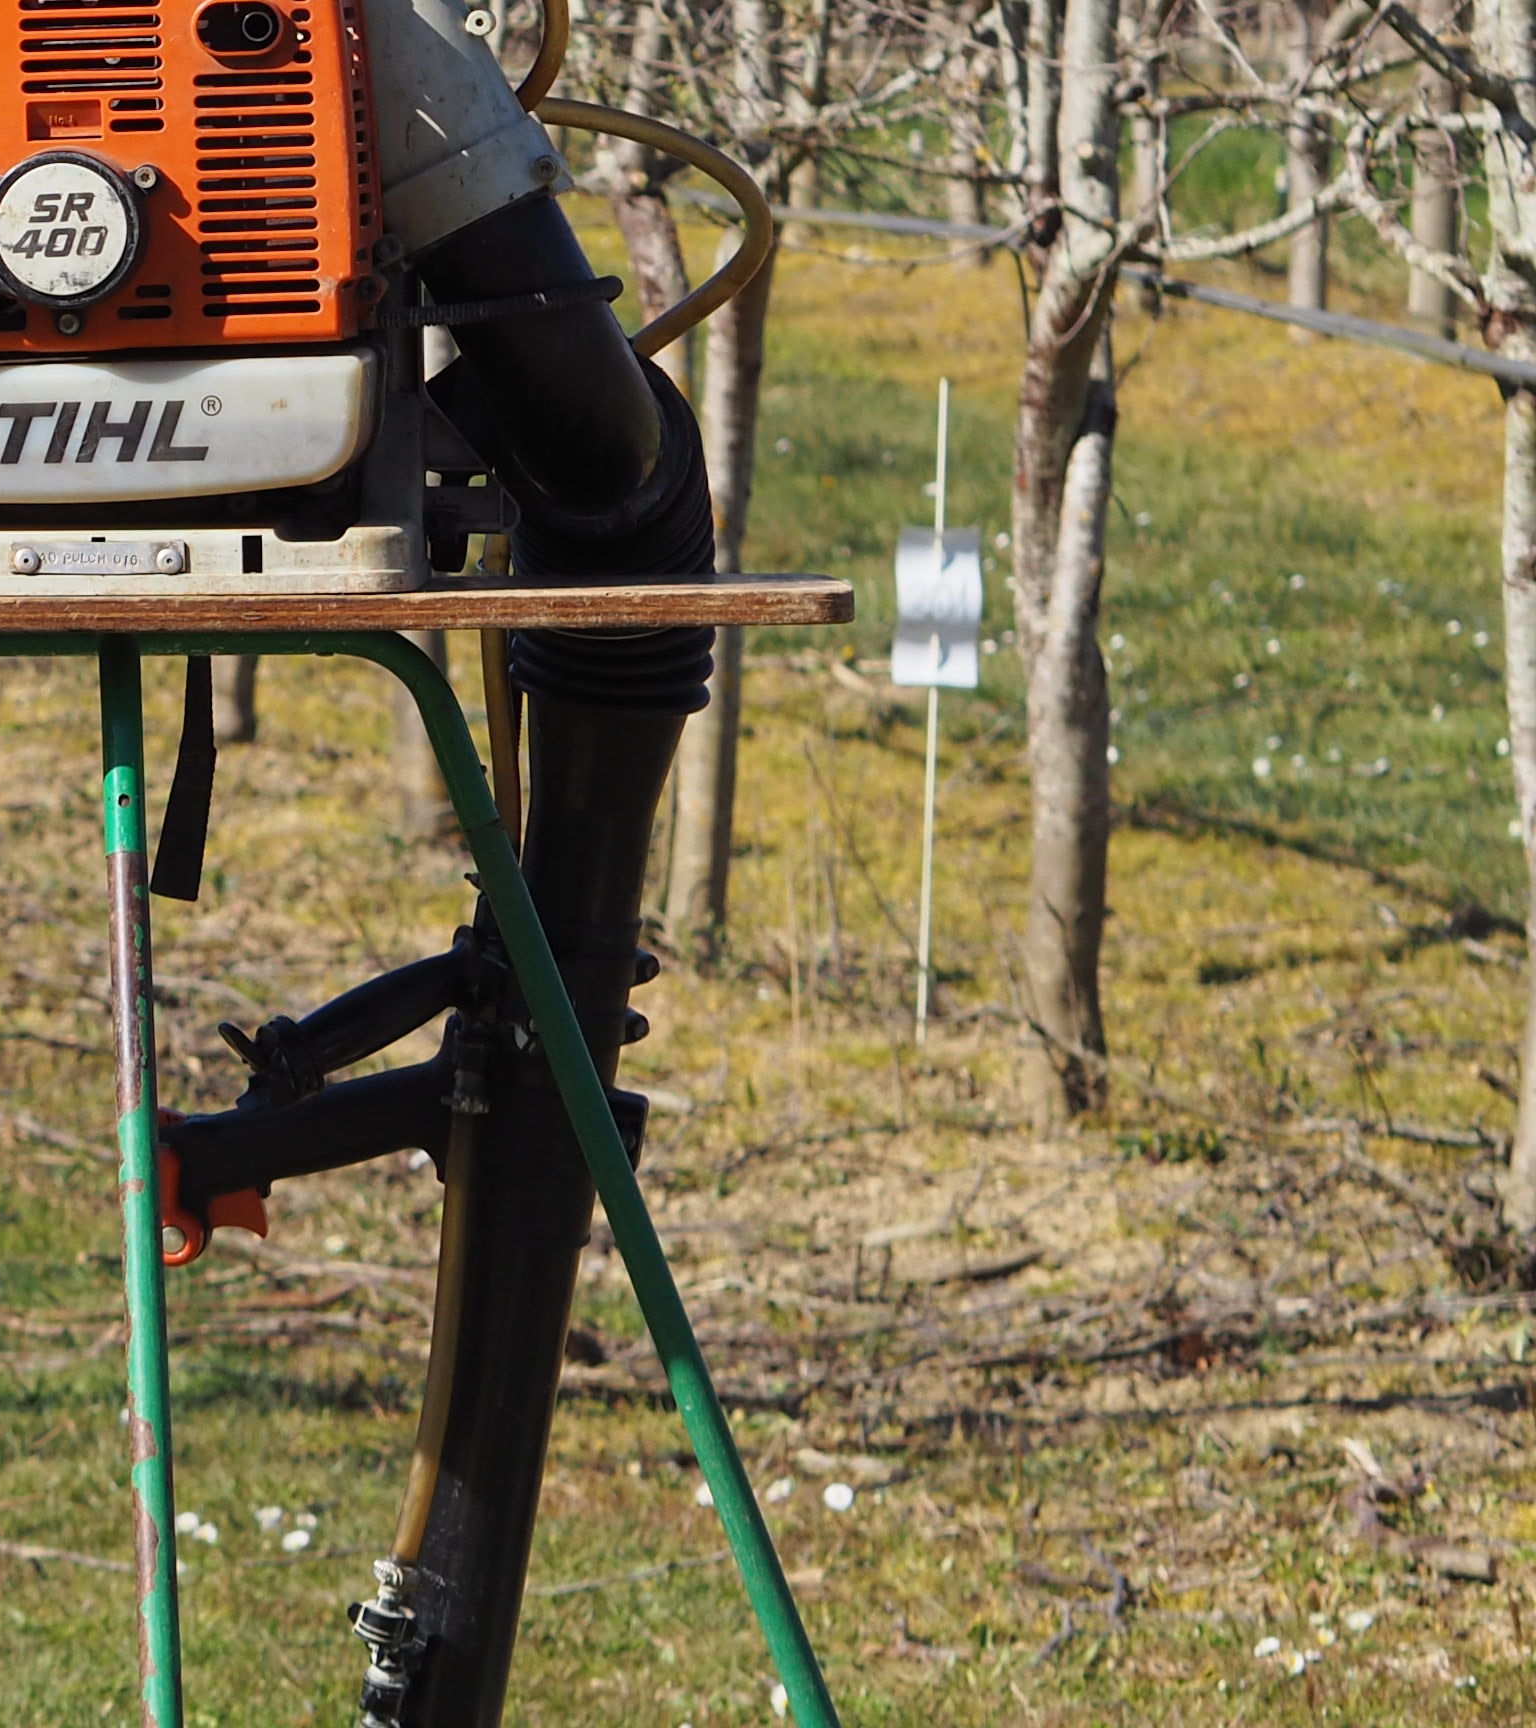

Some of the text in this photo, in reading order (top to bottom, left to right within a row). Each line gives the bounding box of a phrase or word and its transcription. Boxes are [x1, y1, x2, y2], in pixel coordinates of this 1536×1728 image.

[28, 192, 96, 223] SR
[12, 225, 108, 259] 400
[62, 552, 106, 565] PULCH
